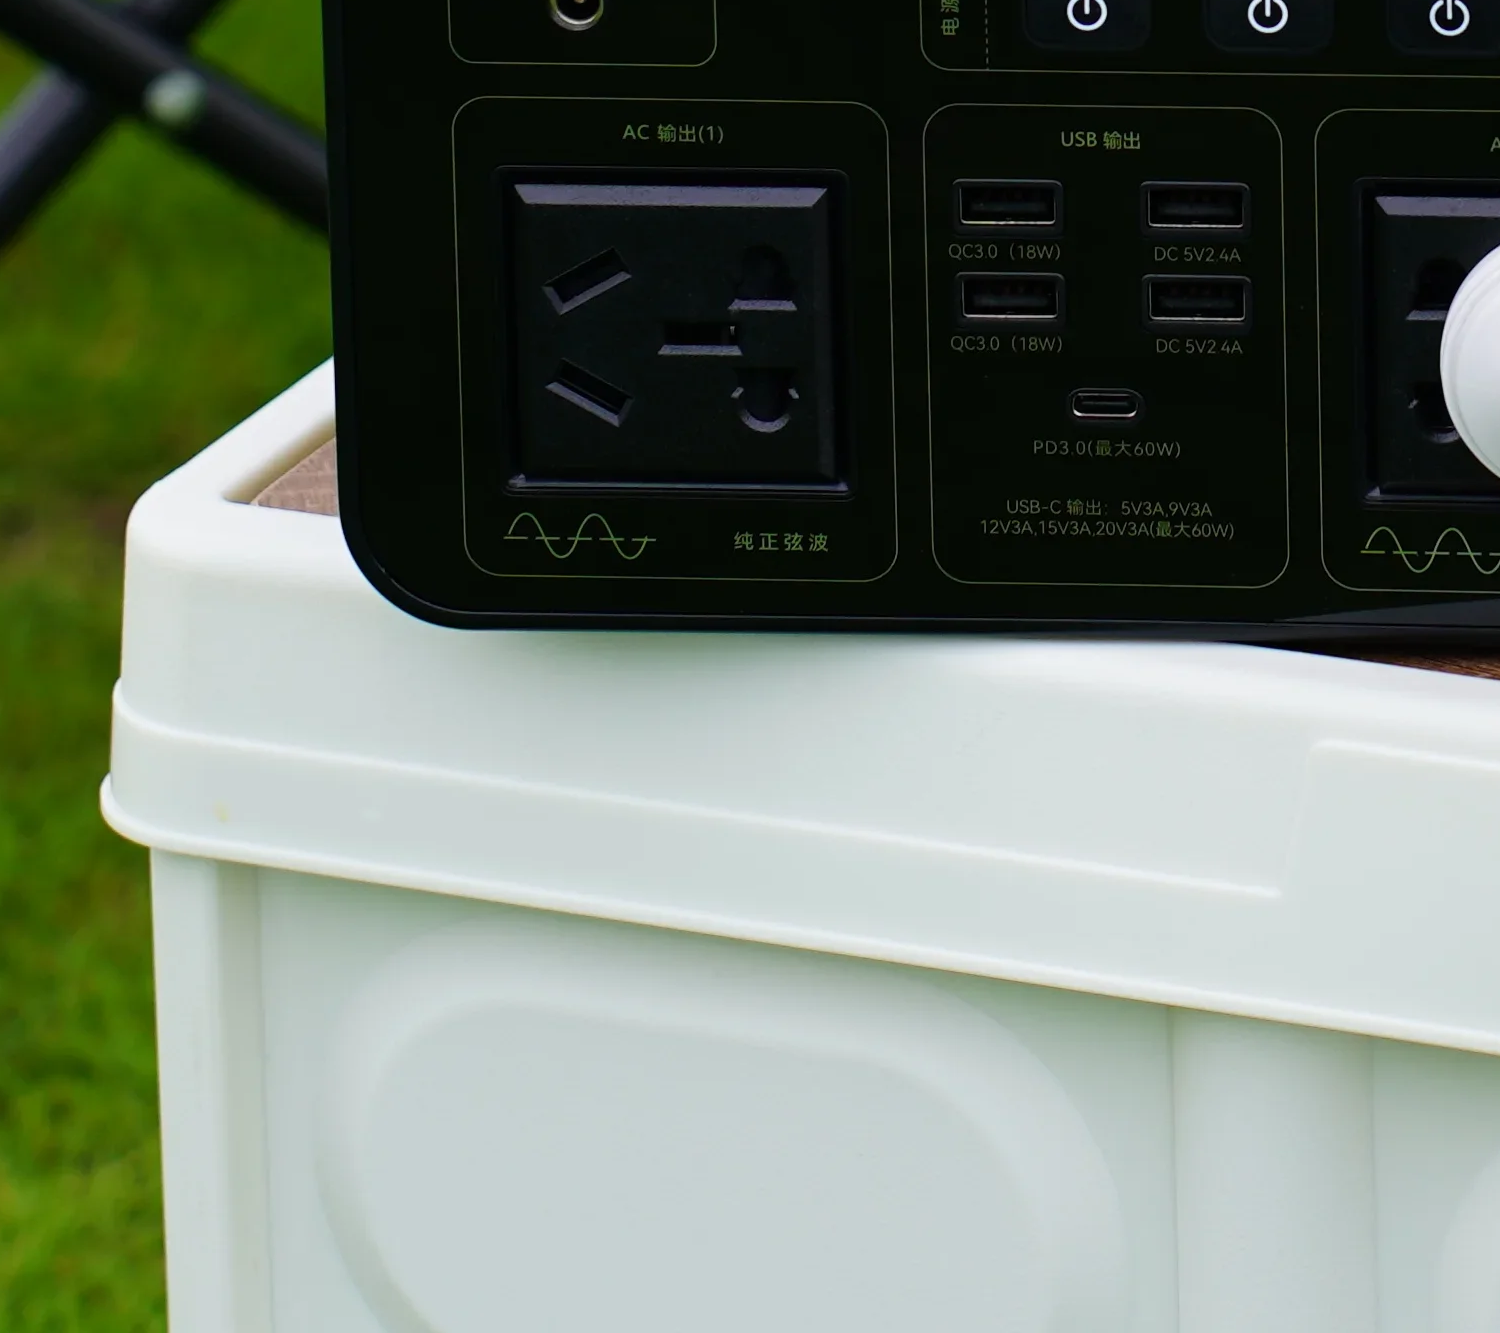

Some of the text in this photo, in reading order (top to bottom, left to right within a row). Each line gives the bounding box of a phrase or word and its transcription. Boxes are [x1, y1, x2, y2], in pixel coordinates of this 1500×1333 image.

[623, 125, 649, 139] AC
[1062, 131, 1140, 149] USB 输出
[1155, 247, 1178, 261] DC
[1156, 339, 1179, 353] DC
[1007, 500, 1061, 514] USB-C
[734, 532, 828, 551] 纯正弦波
